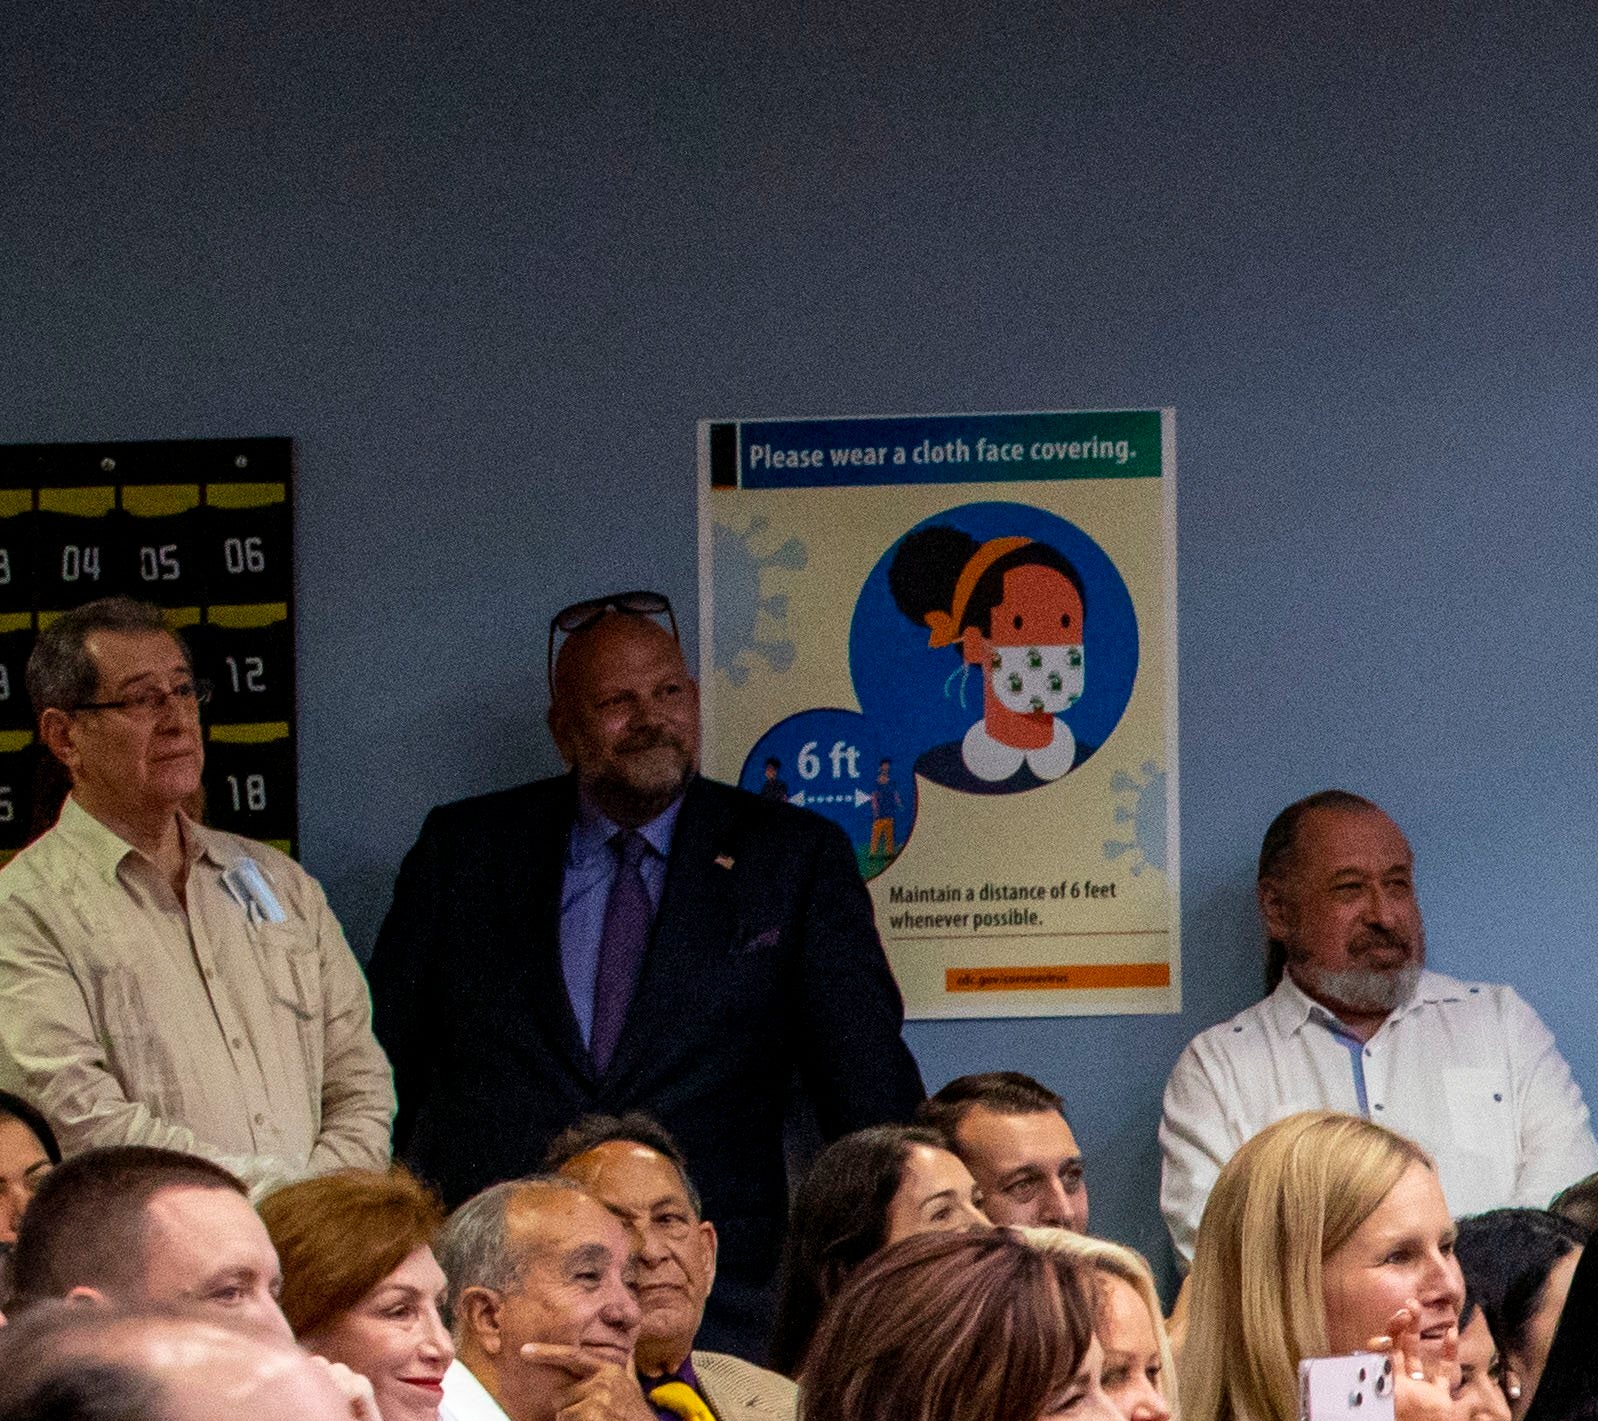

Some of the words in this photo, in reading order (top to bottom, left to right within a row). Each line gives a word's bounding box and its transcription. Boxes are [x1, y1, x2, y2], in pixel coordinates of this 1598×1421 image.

[750, 443, 824, 469] Please
[830, 446, 888, 467] wear
[893, 446, 906, 465] a
[912, 439, 970, 465] cloth
[976, 437, 1023, 461] face
[1030, 436, 1137, 465] covering.
[62, 545, 100, 581] 04
[140, 545, 181, 581] 05
[224, 537, 266, 574] 06
[225, 656, 266, 692] 12
[798, 741, 821, 780] 6
[829, 740, 861, 779] ft
[226, 774, 267, 811] 18
[889, 886, 961, 903] Maintain
[966, 889, 975, 901] a
[979, 884, 1046, 901] distance
[1050, 881, 1066, 899] of
[1070, 882, 1081, 898] 6
[1084, 881, 1117, 898] feet
[889, 911, 969, 929] whenever
[973, 908, 1043, 931] possible.
